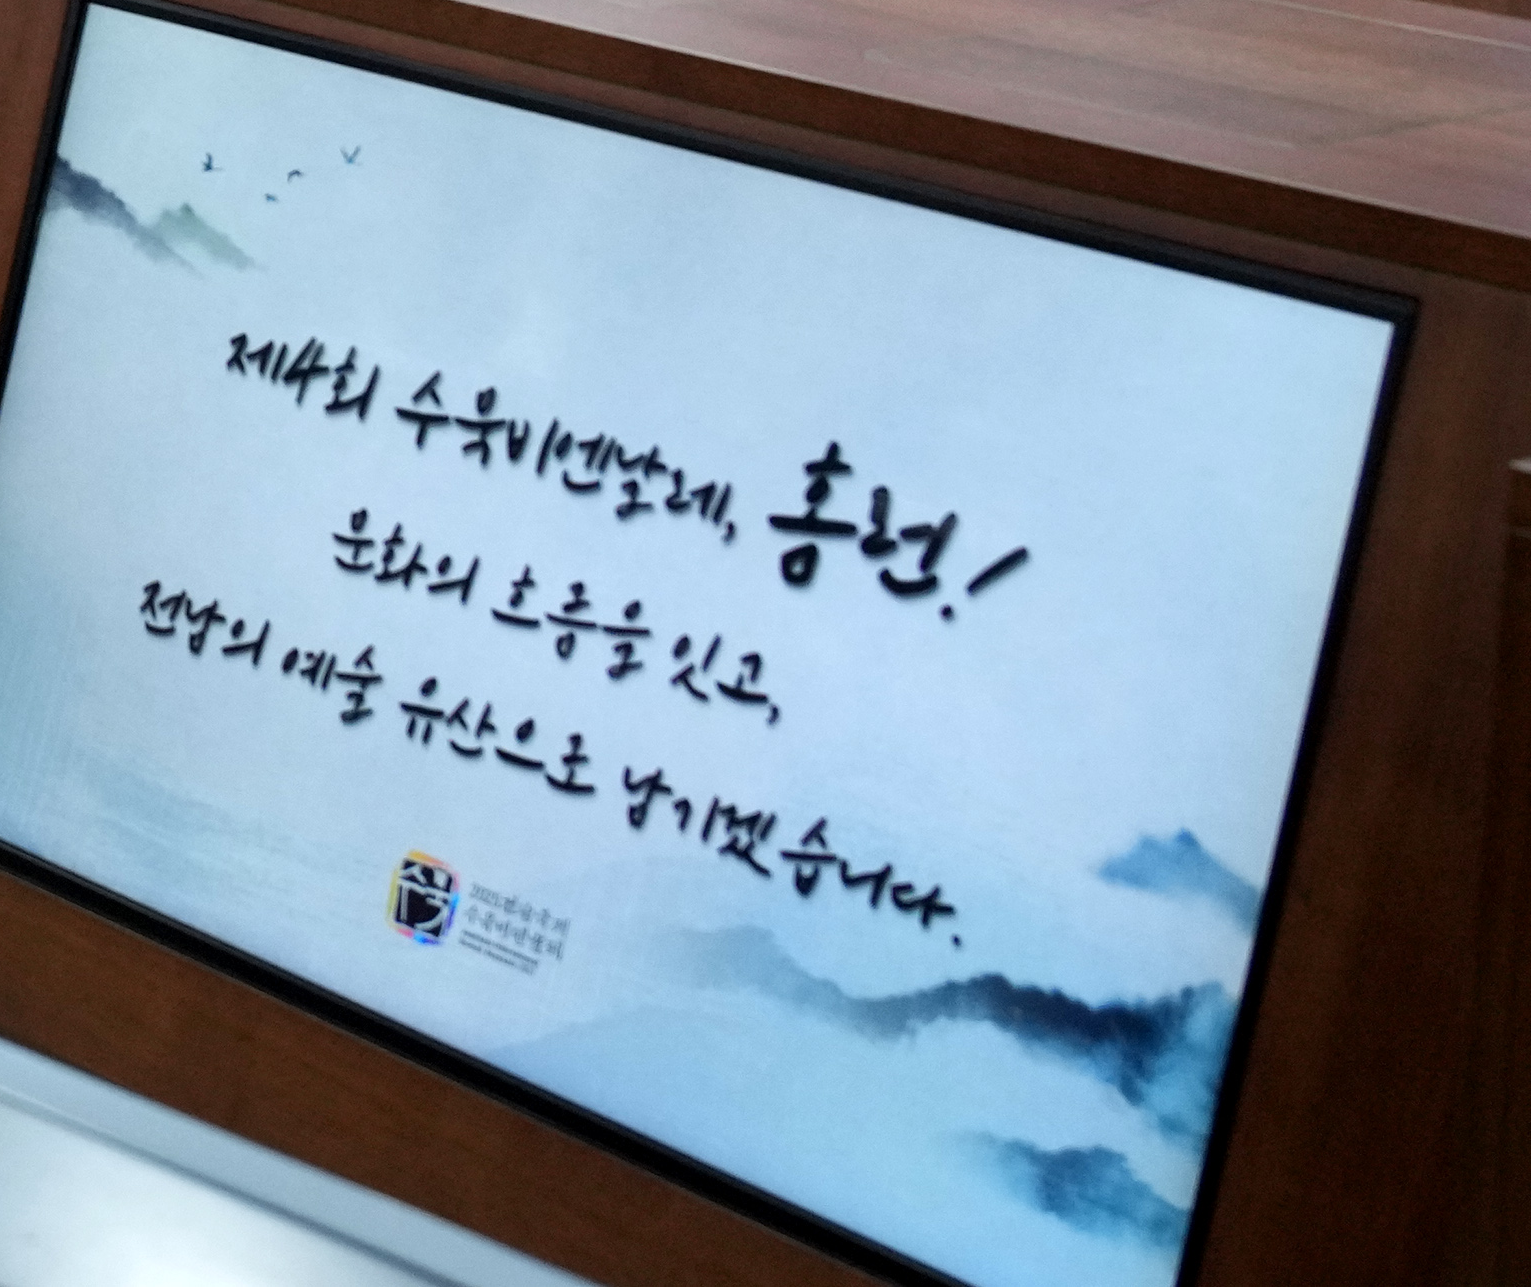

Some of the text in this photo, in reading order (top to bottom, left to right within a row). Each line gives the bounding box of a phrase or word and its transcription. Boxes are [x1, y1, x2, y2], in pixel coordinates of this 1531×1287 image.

[225, 332, 380, 421] 제4회
[394, 371, 736, 543] 수묵비엔날레,
[332, 507, 780, 725] 문화의 흐름을 잇고,
[139, 580, 961, 947] 전남의 예술 유산으로 남기겠습니다.
